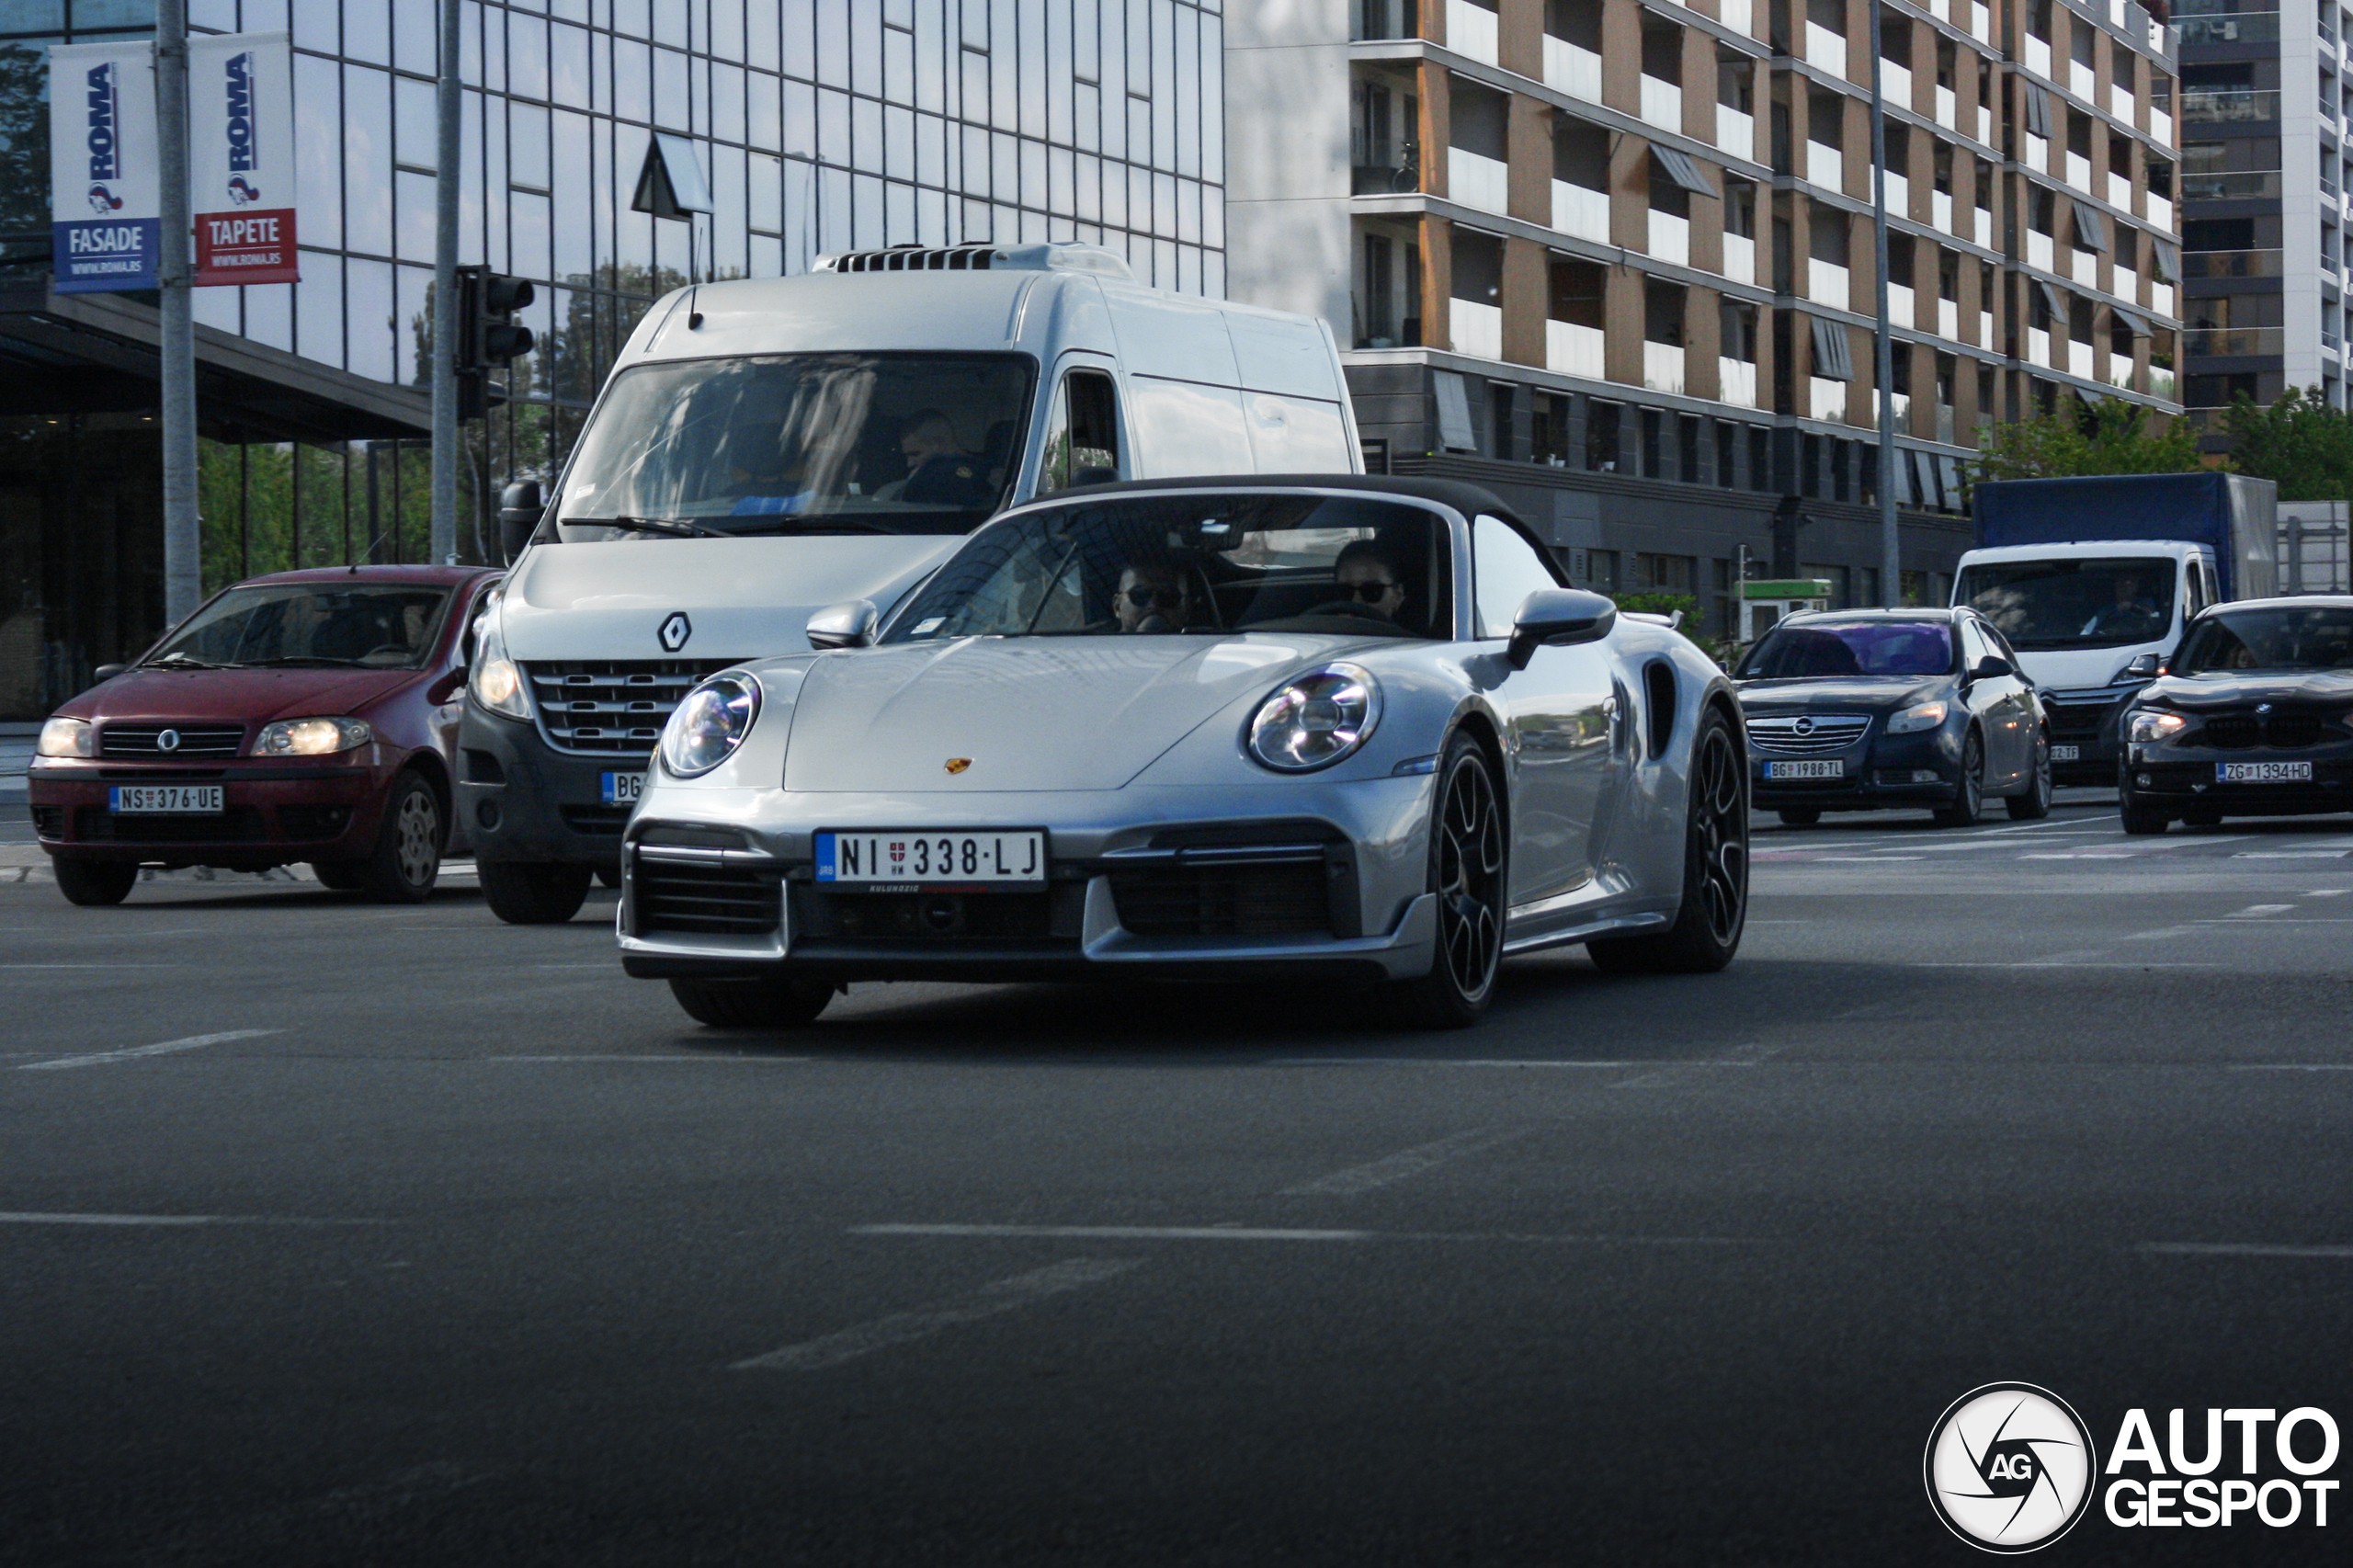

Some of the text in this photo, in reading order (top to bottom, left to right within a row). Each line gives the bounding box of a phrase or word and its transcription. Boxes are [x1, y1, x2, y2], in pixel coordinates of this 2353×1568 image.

[88, 62, 113, 180] ROMA
[225, 52, 250, 172] ROMA
[70, 227, 142, 253] FASADE
[209, 218, 279, 245] TAPETE
[70, 260, 142, 275] WWW.ROMA.RS
[211, 253, 281, 267] WWW.ROMA.RS
[2227, 765, 2244, 779] ZG
[618, 776, 641, 798] BG
[122, 790, 143, 809] NS
[841, 838, 877, 875] NI
